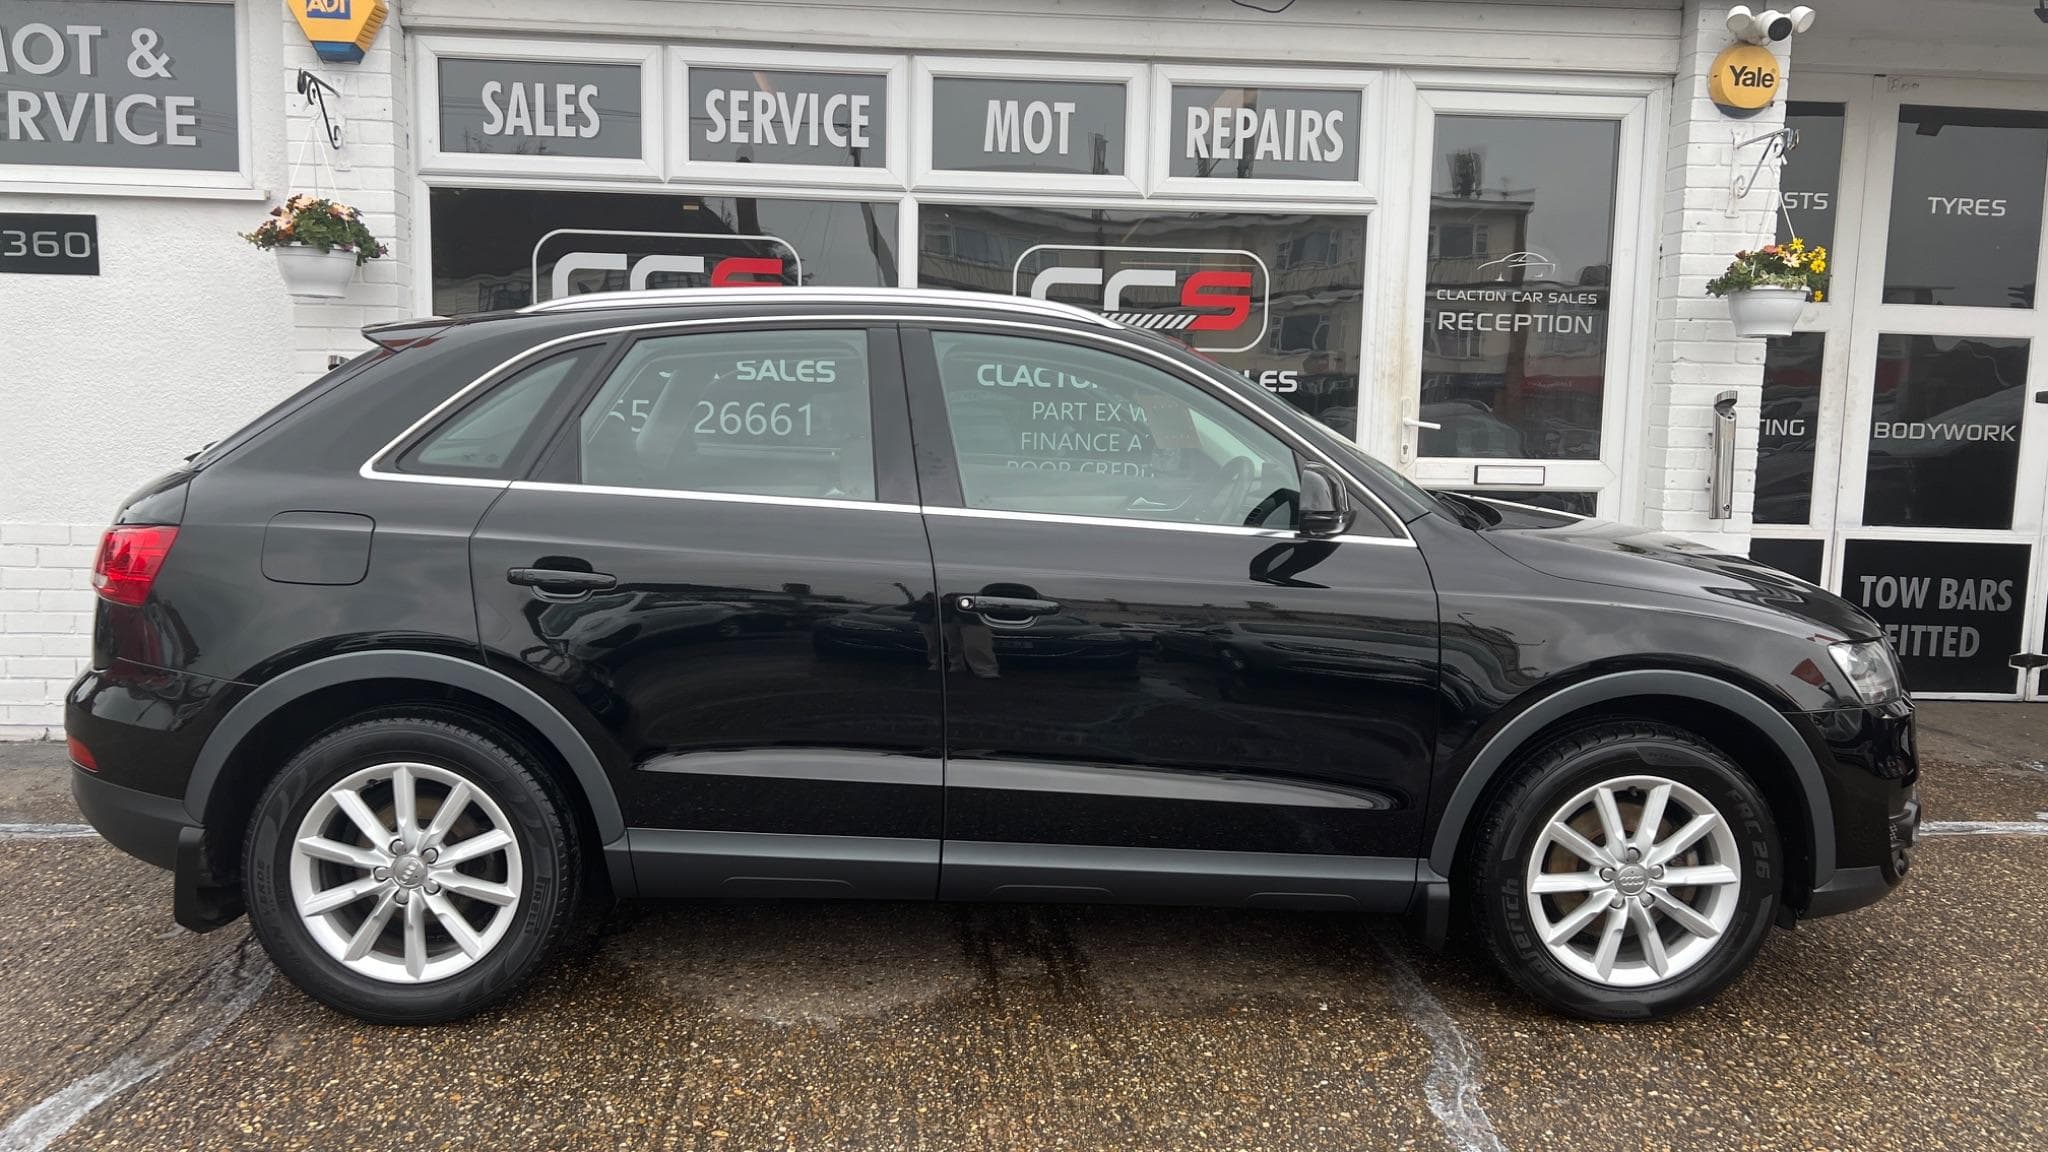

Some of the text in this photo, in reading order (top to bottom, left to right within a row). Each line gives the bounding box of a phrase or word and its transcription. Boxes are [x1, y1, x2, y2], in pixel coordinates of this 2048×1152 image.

[0, 22, 173, 78] OT &
[1729, 65, 1775, 89] Yale
[7, 90, 197, 146] RVICE
[481, 80, 600, 139] SALES
[704, 88, 870, 148] SERVICE
[983, 100, 1076, 155] MOT
[1185, 105, 1345, 163] REPAIRS
[1784, 192, 1829, 210] STS
[1928, 196, 2007, 217] TYRES
[2, 230, 91, 258] 360
[1436, 289, 1598, 305] CLACTON CAR SALES
[1437, 311, 1593, 334] RECEPTION
[736, 359, 836, 383] SALES
[976, 364, 1098, 389] CLACTO
[694, 401, 813, 436] 26661
[1032, 401, 1088, 421] PART
[1095, 402, 1122, 422] EX
[1021, 431, 1121, 452] FINANCE
[1873, 420, 2017, 444] BODYWORK
[1080, 462, 1154, 478] CREDI
[1860, 575, 2014, 612] TOW BARS
[1883, 624, 1980, 658] FITTED
